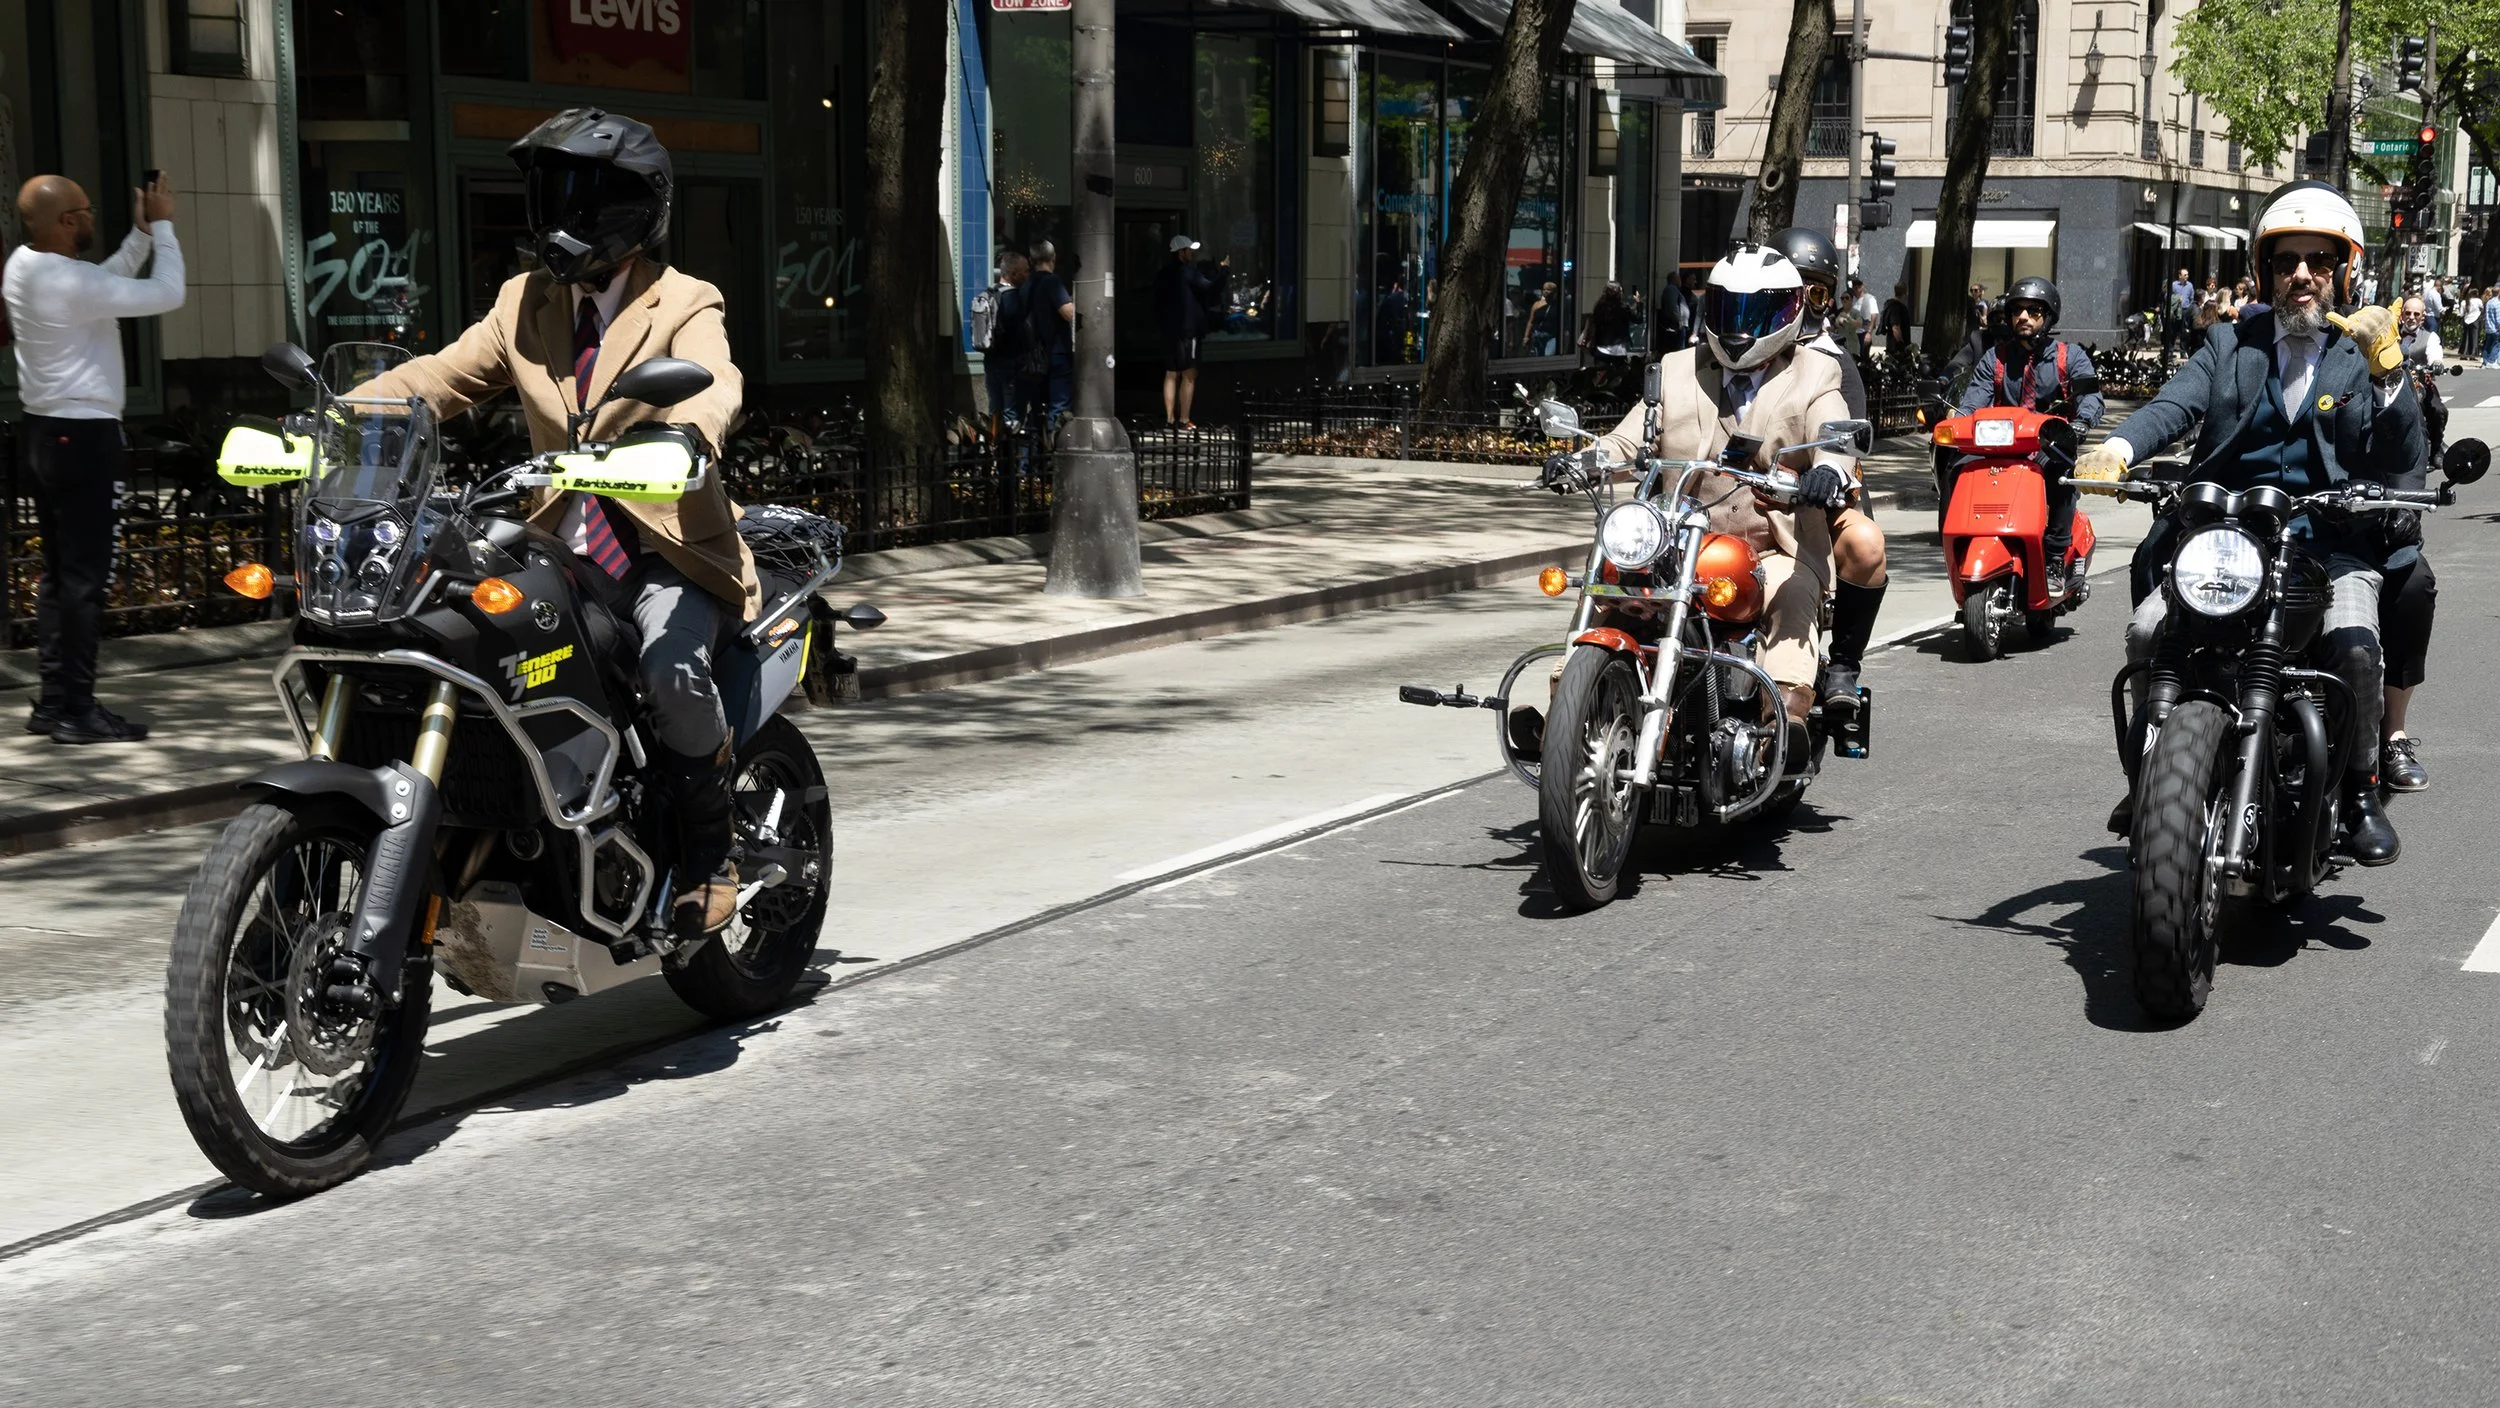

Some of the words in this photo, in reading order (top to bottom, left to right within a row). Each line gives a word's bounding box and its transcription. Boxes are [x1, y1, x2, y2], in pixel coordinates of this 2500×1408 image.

[2380, 142, 2409, 152] Ontario
[1134, 167, 1153, 185] 600
[330, 191, 355, 213] 150
[356, 191, 400, 214] YEARS
[795, 207, 812, 225] 150
[814, 207, 843, 226] YEARS
[353, 220, 363, 234] OF
[365, 220, 380, 234] THE
[2410, 246, 2428, 255] ONE
[573, 478, 648, 492] Barkbusters
[778, 641, 800, 664] YAMAHA
[366, 836, 408, 911] YAMAHA
